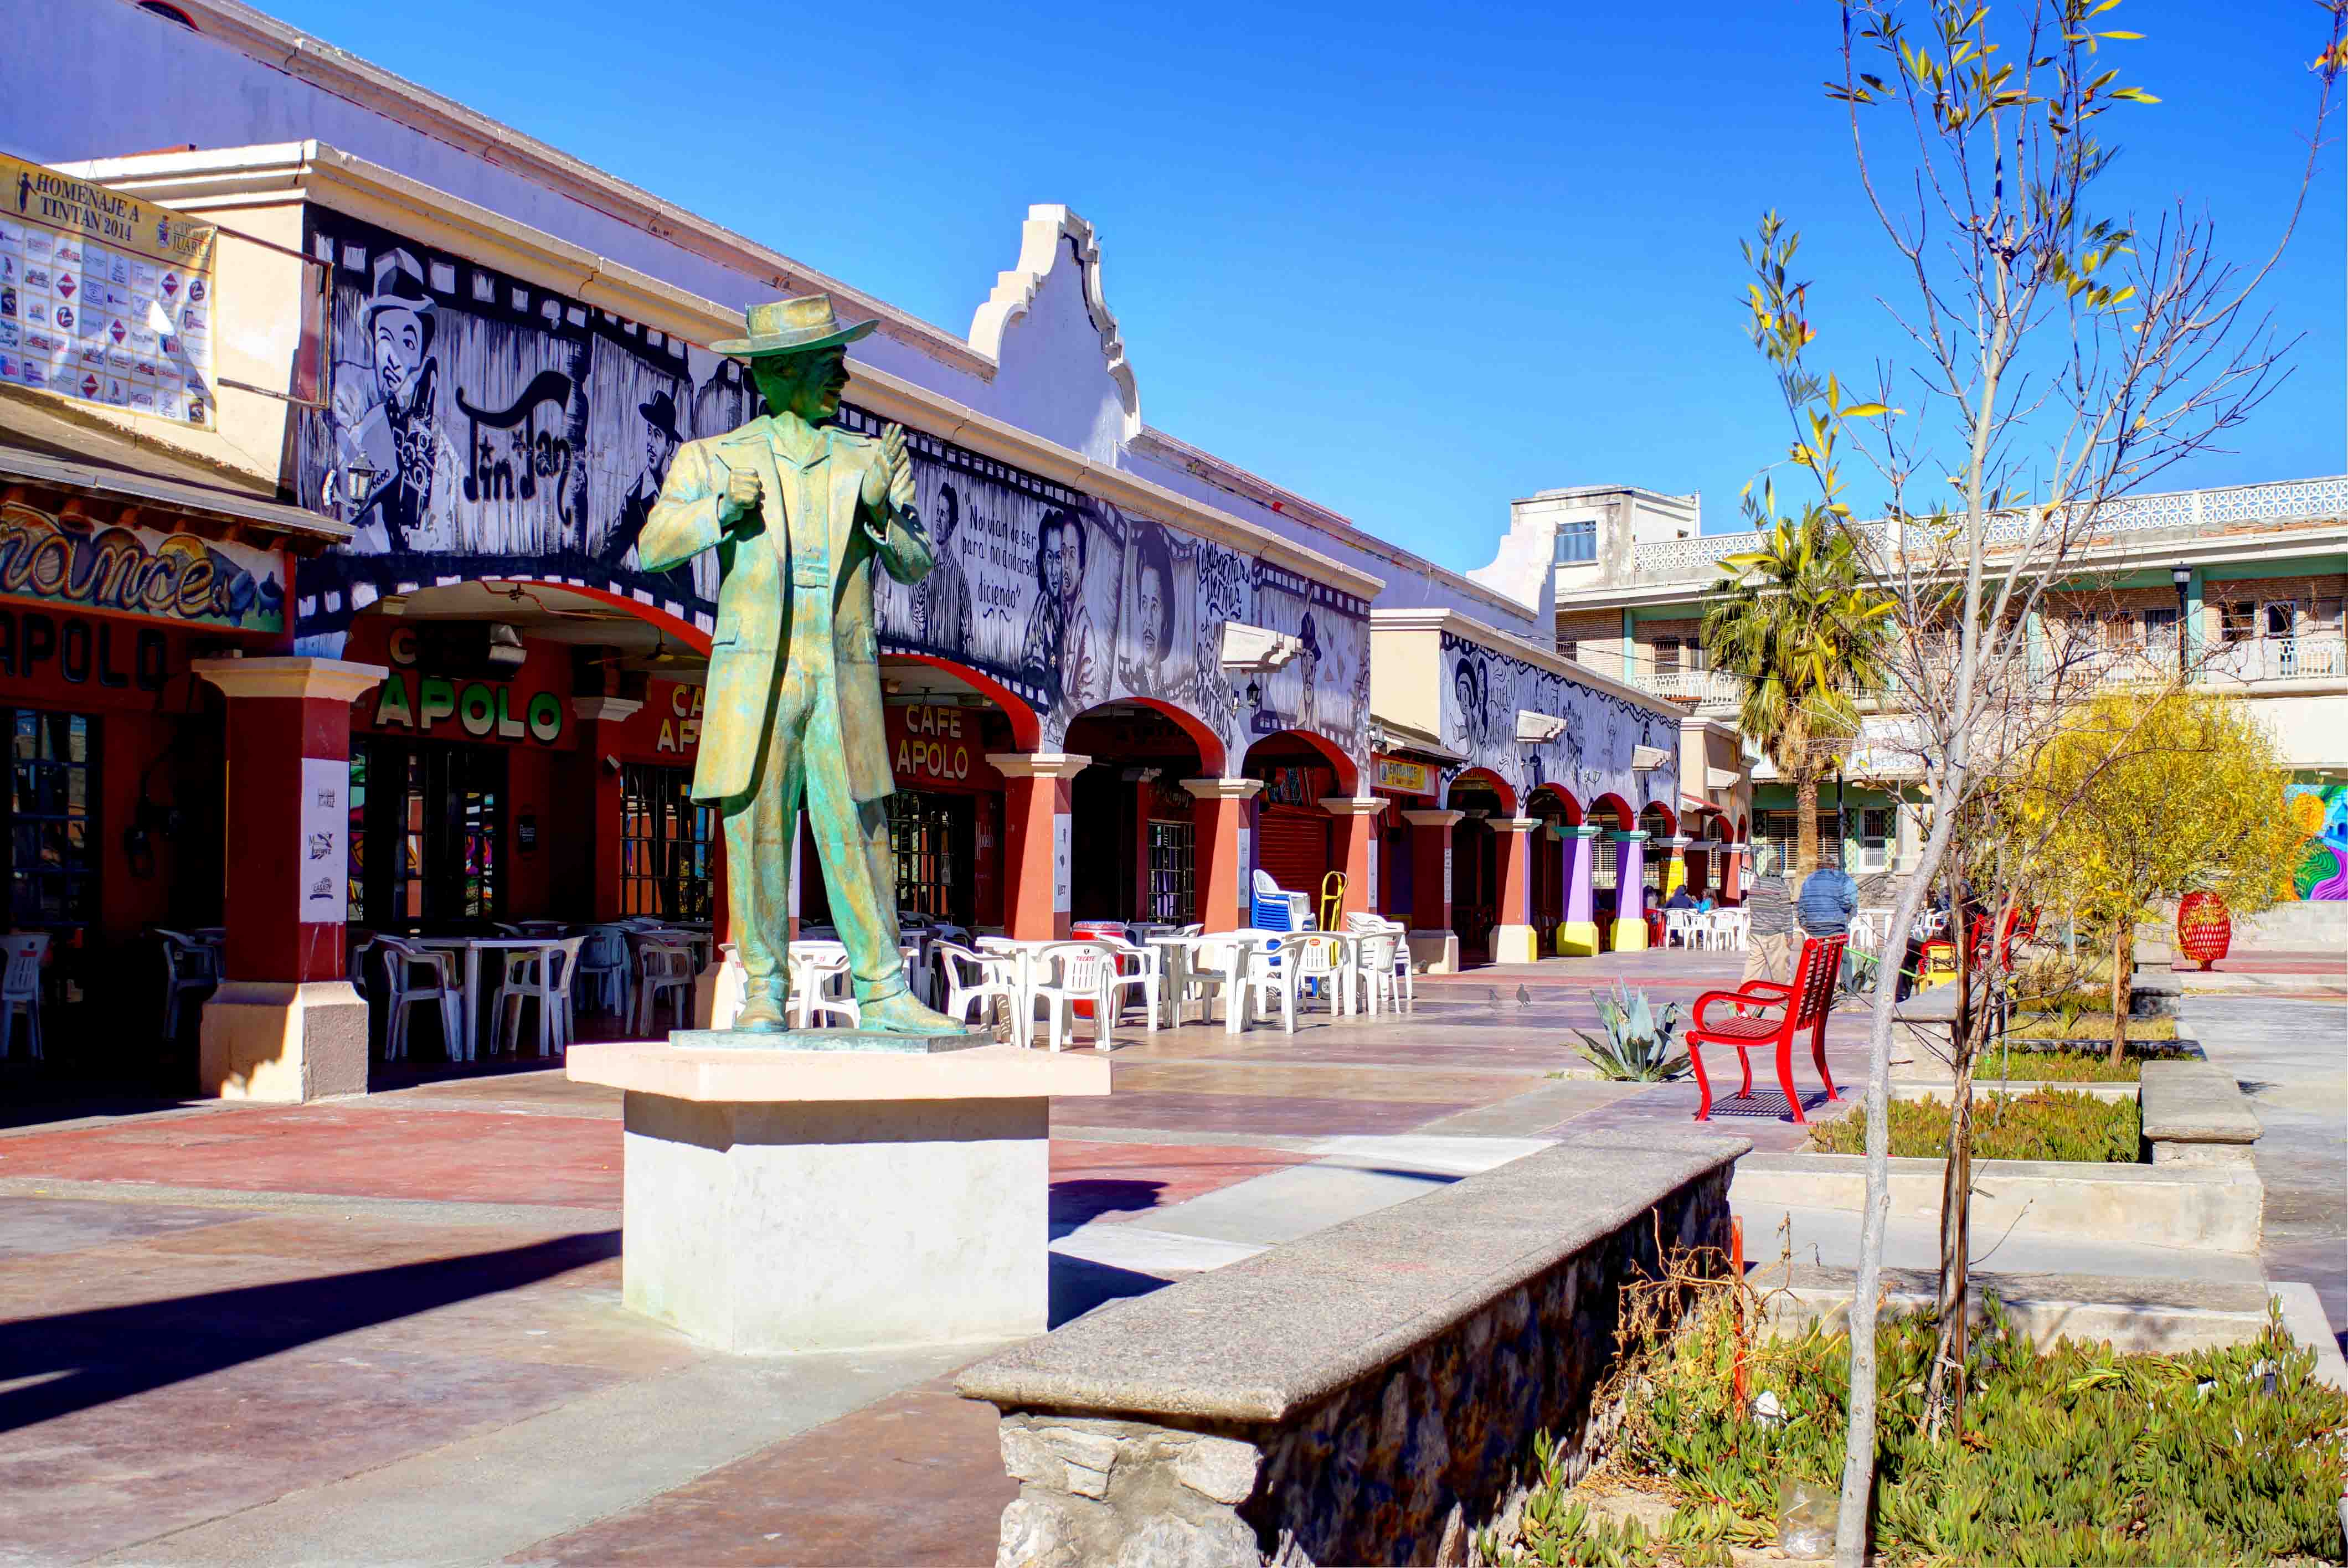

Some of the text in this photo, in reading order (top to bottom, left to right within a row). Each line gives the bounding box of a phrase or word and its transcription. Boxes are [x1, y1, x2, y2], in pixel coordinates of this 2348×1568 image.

[36, 173, 140, 223] HOMENAJE A
[40, 197, 133, 242] TINTAN 2014
[962, 535, 985, 568] para
[990, 544, 1000, 566] no
[1011, 516, 1019, 545] de
[1022, 529, 1036, 551] ser
[376, 673, 562, 740] APOLO
[906, 704, 962, 739] CAFE
[896, 740, 969, 780] APOLO
